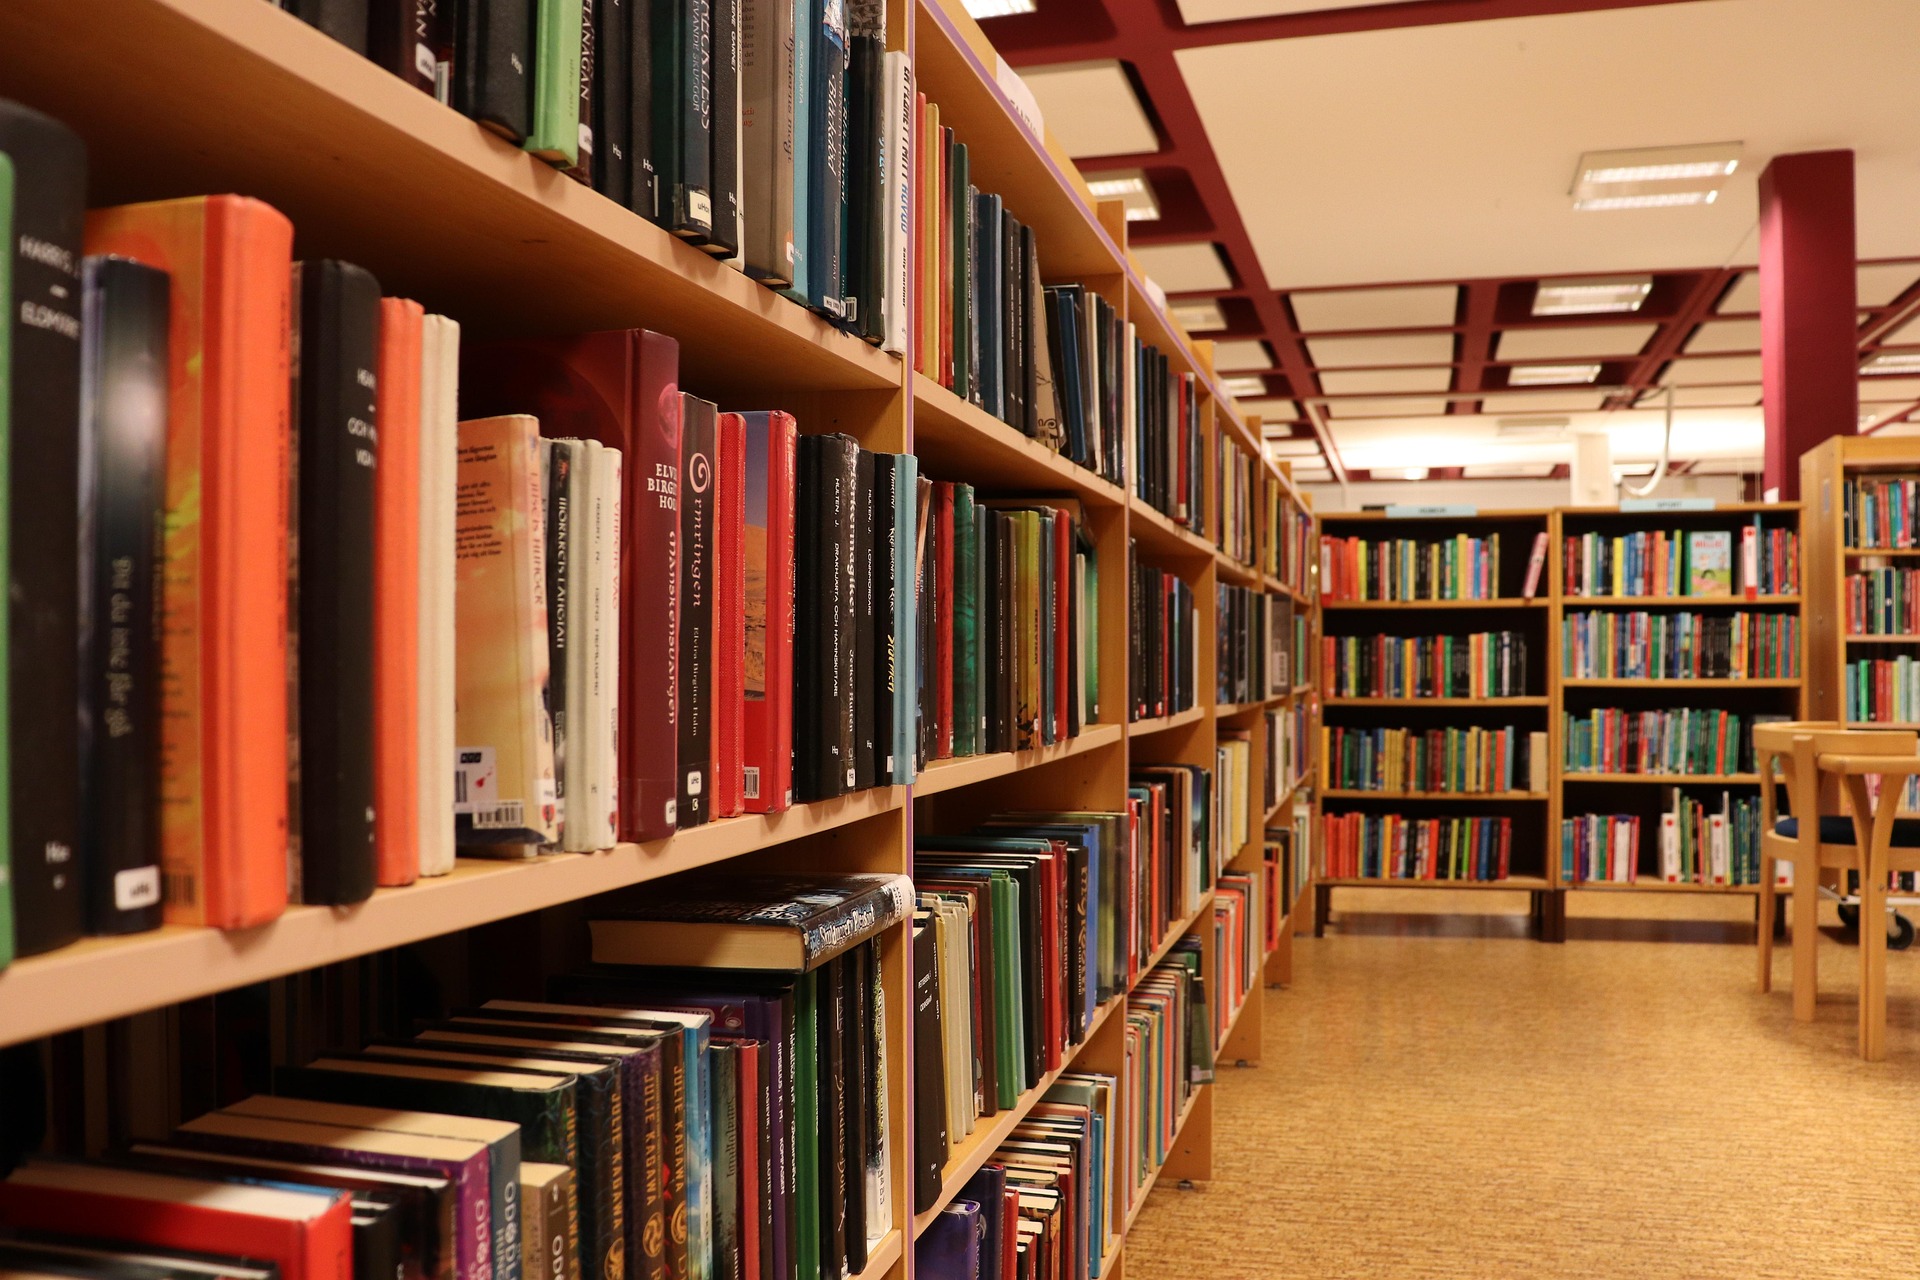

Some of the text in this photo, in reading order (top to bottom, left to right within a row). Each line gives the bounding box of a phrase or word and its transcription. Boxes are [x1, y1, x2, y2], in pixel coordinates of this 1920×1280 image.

[643, 1074, 657, 1206] JULIE KAGAWA
[674, 1065, 684, 1114] JULIE
[611, 1093, 624, 1229] JULIE KAGAWA
[674, 1121, 686, 1192] KAGAWA
